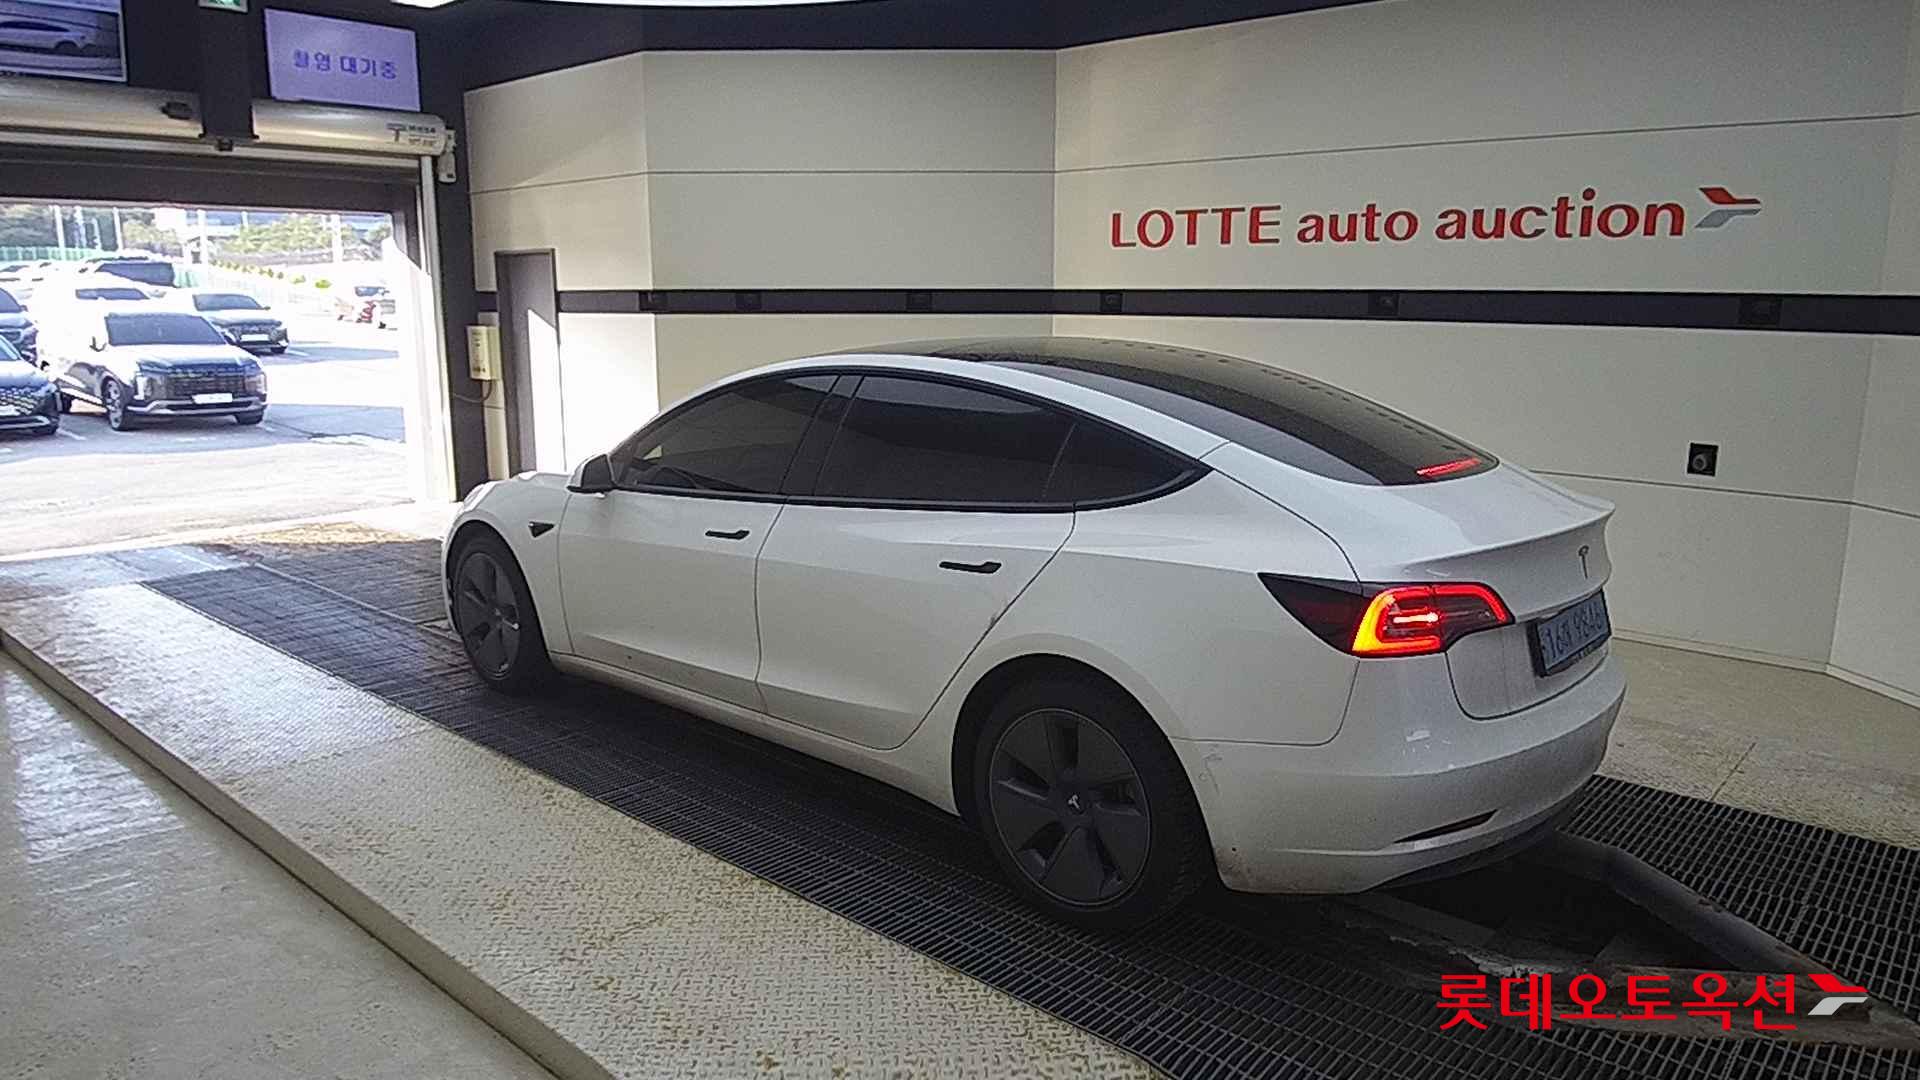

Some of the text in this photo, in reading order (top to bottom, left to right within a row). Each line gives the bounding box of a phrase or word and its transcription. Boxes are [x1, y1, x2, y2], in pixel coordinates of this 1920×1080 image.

[340, 55, 397, 79] 대기중
[1111, 188, 1685, 248] LOTTE auto auction
